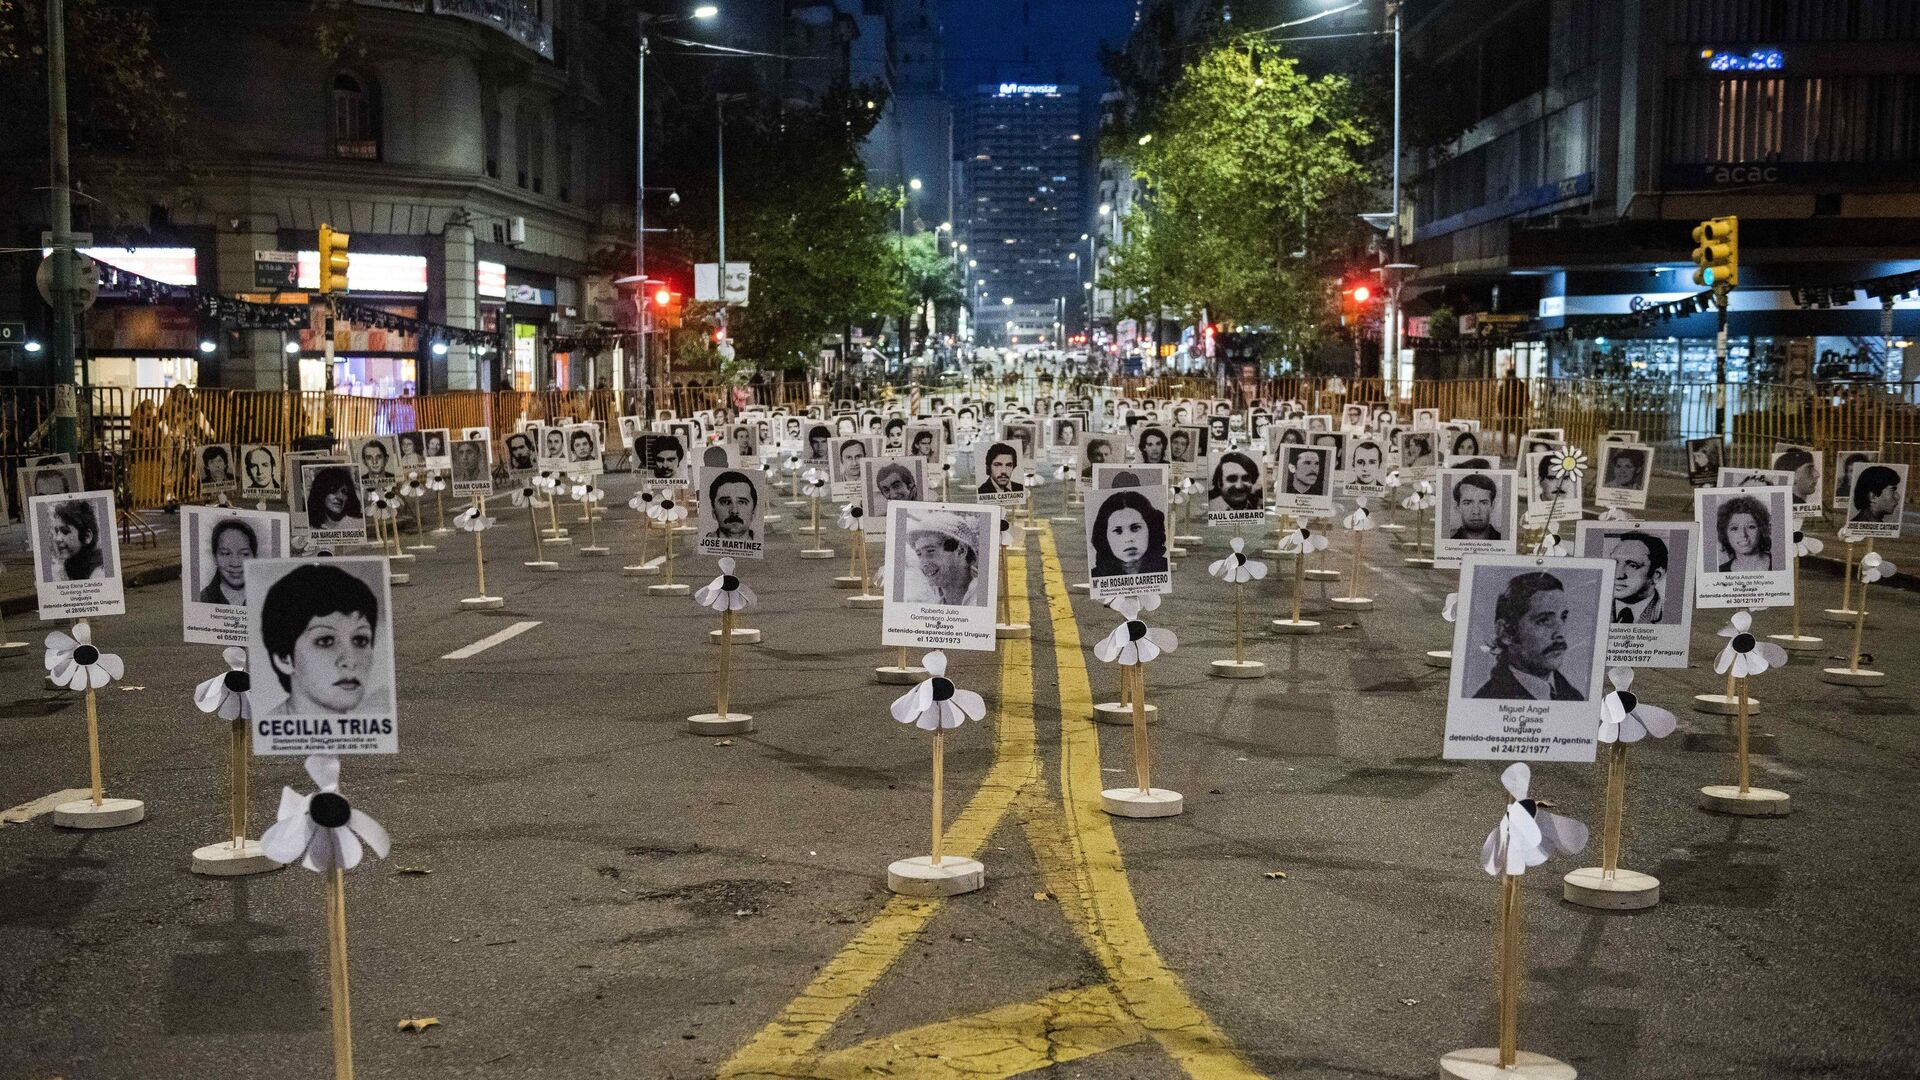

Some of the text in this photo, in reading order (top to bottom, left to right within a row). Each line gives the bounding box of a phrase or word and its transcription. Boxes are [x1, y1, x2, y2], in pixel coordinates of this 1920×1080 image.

[1018, 85, 1057, 93] movistar
[1715, 167, 1777, 182] acac
[1208, 511, 1264, 520] RAÚL GÁMBARO
[311, 531, 320, 539] ADA
[700, 537, 762, 551] JOSÉ MARTÍNEZ
[1100, 579, 1109, 588] del
[1109, 577, 1134, 587] ROSARIO
[1135, 574, 1168, 585] CARRETERO
[910, 614, 969, 623] Gomensoro Josman
[925, 622, 954, 630] Uruguayo
[887, 628, 955, 636] detenido-desaparecido
[925, 636, 961, 644] 12/03/1973
[1498, 704, 1550, 715] Miguel Ángel
[1519, 715, 1544, 723] Casas
[258, 718, 393, 736] CECILIA TRIAS
[1503, 726, 1542, 735] Uruguayo
[1449, 734, 1540, 743] detenido-desaparecido
[1491, 745, 1550, 754] el 24/12/1977
